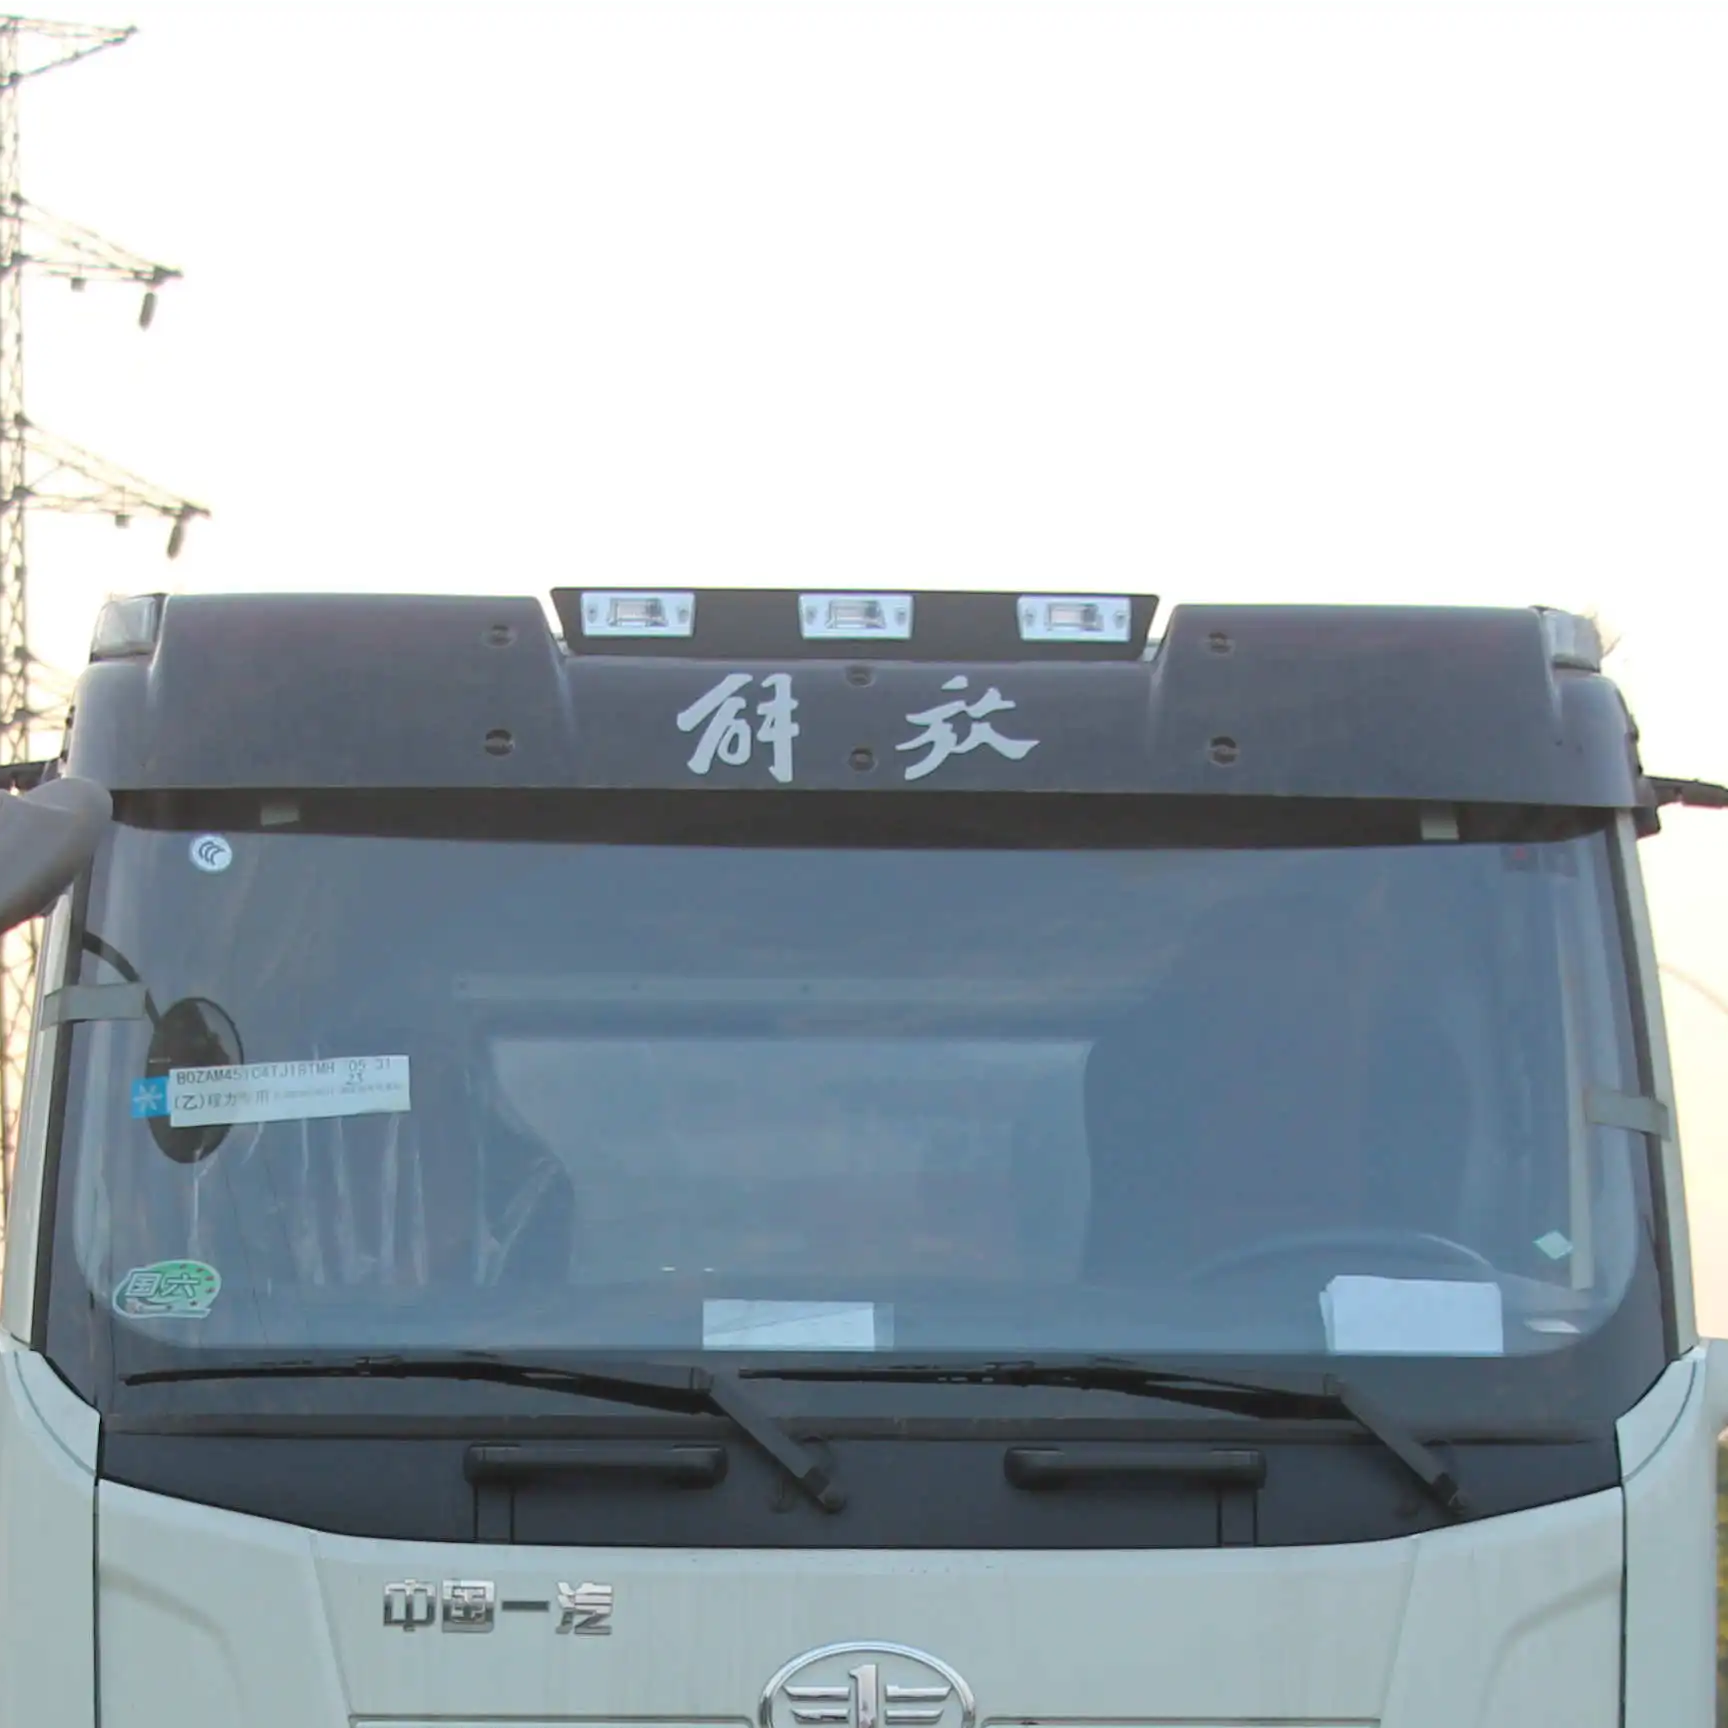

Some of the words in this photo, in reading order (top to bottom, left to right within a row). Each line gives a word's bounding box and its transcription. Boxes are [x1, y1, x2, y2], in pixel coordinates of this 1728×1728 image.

[124, 1270, 201, 1299] 国六
[383, 1578, 613, 1635] 中国一汽
